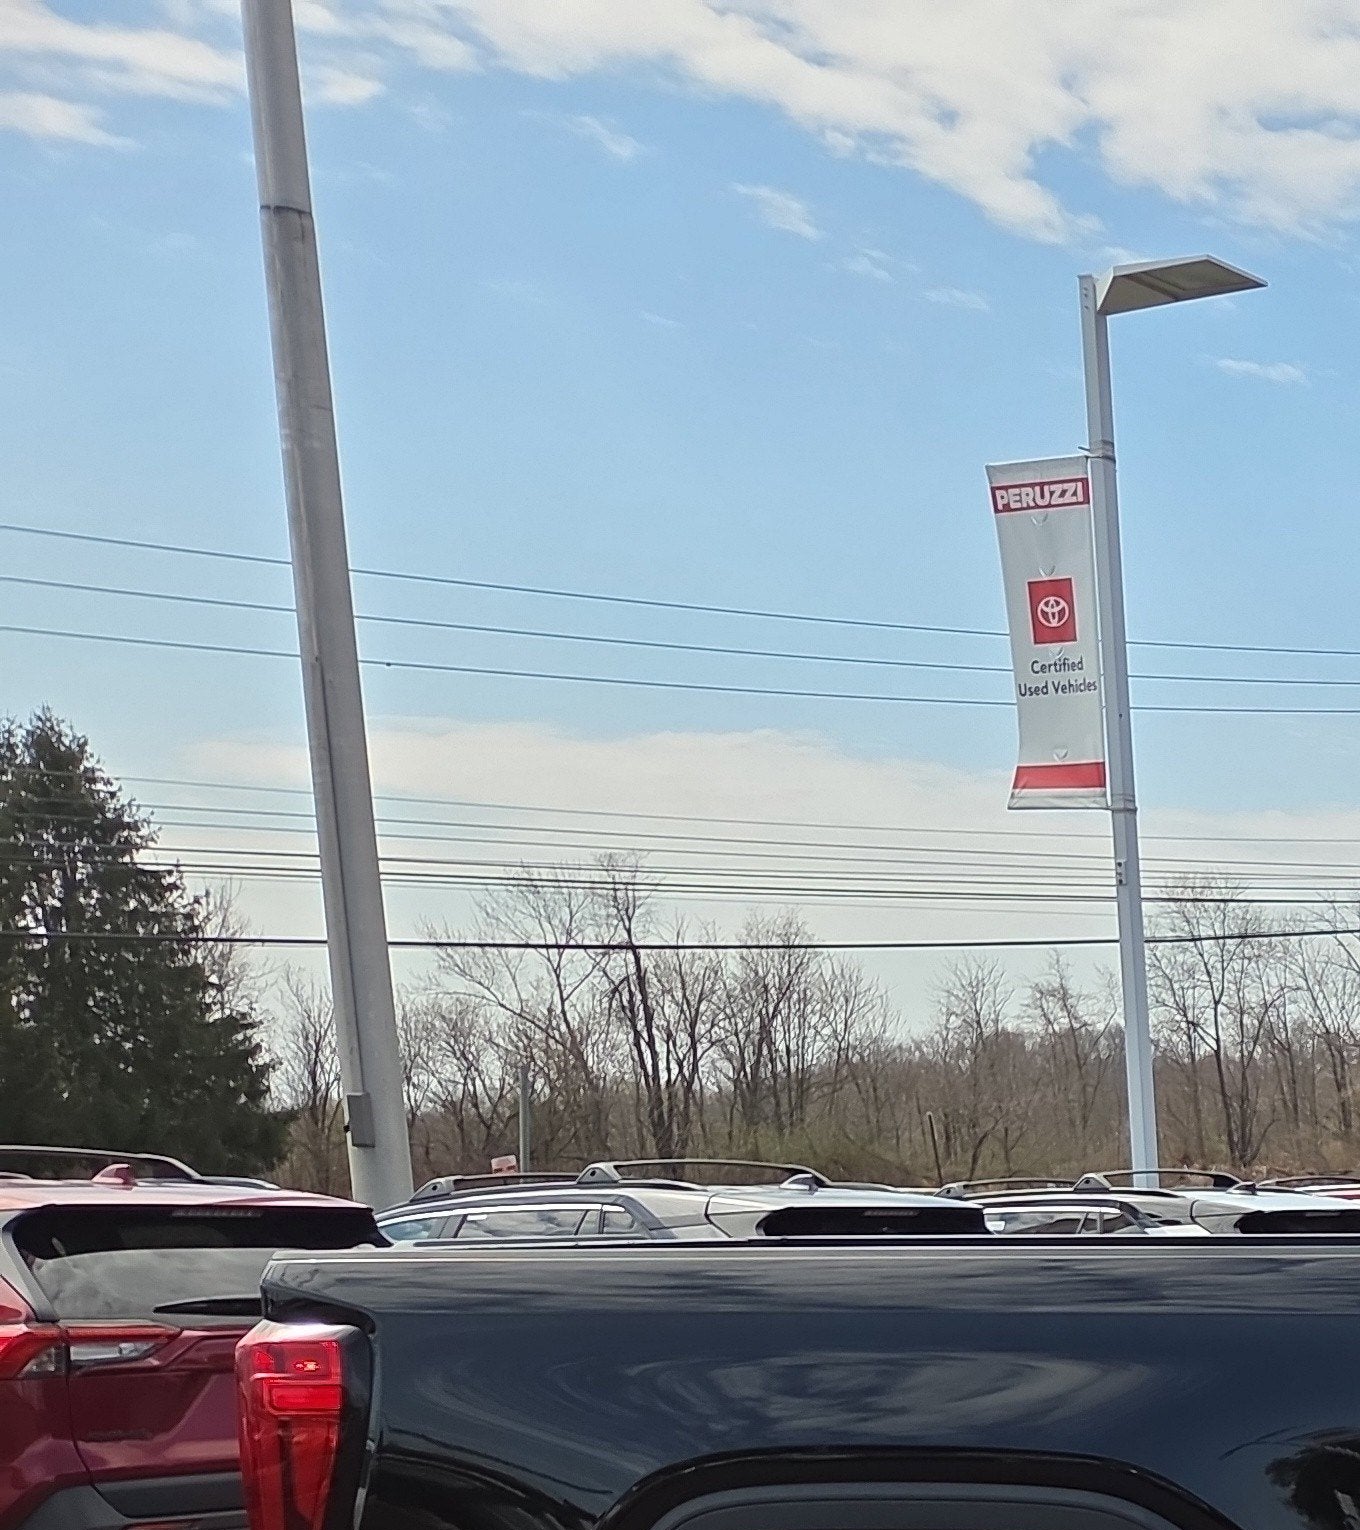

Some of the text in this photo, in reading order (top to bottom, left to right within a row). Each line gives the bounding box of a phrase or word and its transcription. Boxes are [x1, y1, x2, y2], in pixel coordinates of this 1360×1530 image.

[996, 481, 1084, 511] PERUZZI
[1031, 655, 1084, 674] Certified
[1018, 677, 1097, 697] Used Vehicles
